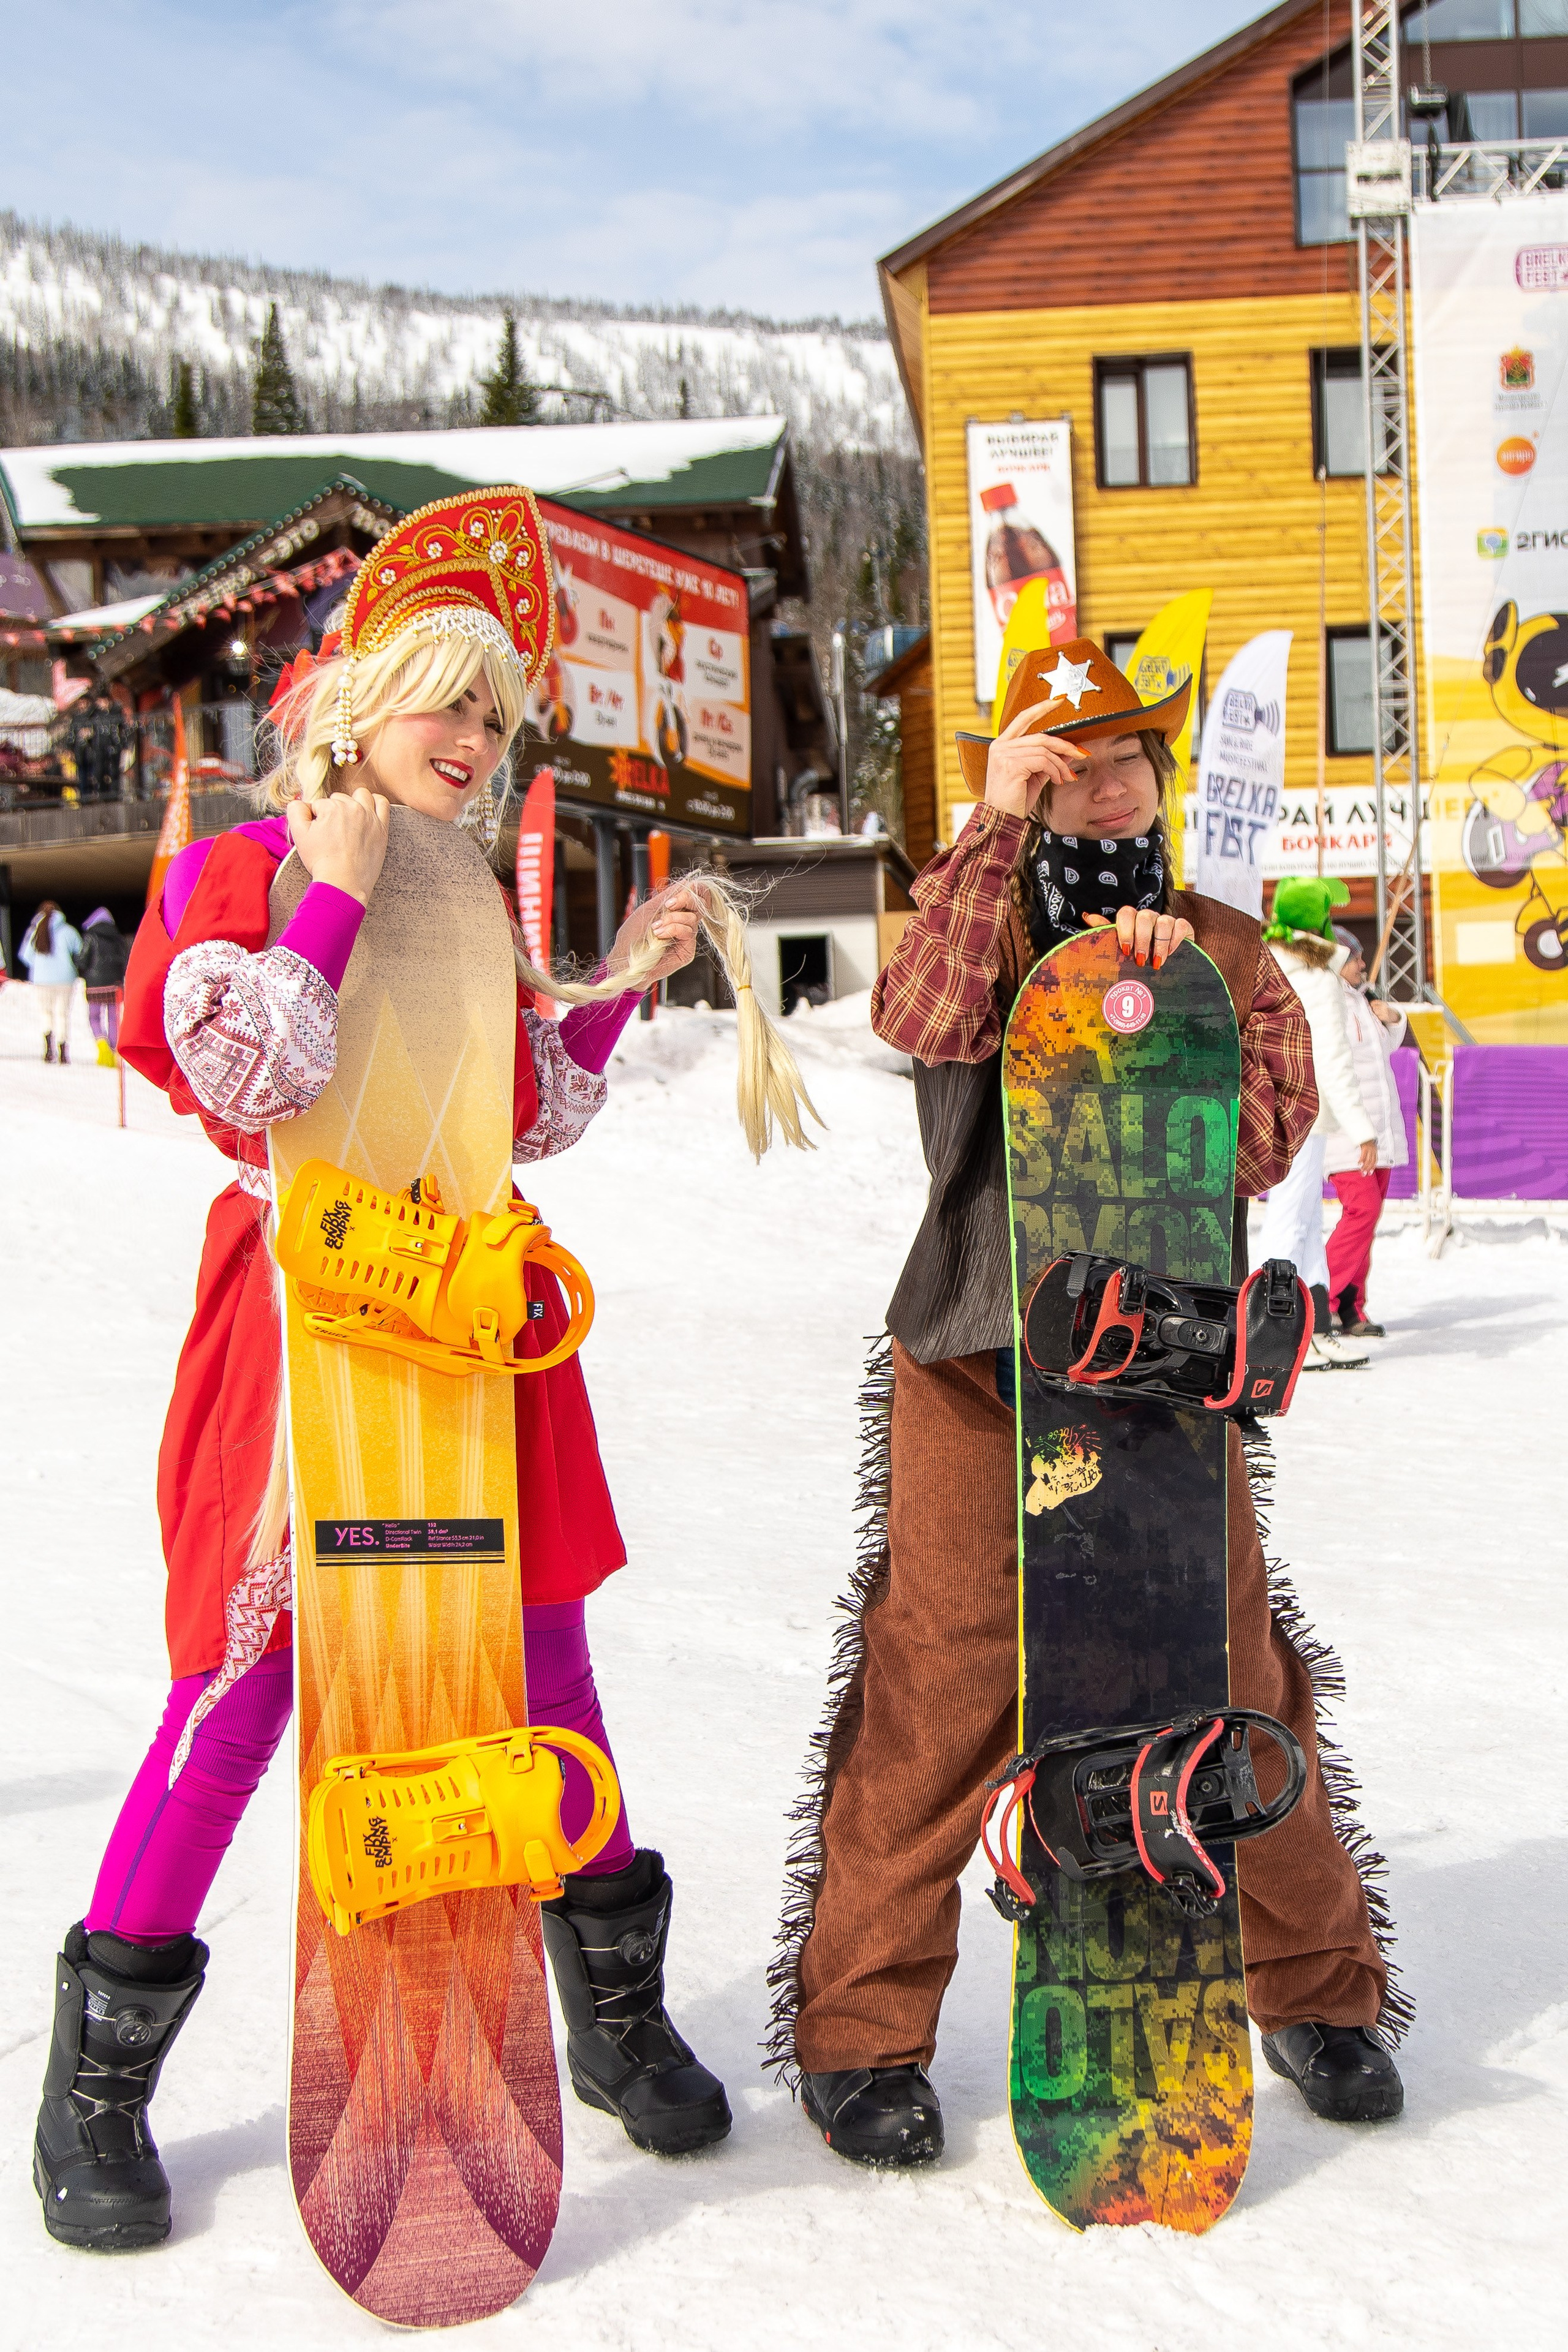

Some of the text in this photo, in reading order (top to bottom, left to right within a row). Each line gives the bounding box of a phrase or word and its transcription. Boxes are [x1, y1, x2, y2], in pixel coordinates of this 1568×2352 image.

[1109, 986, 1134, 1000] прокат
[1121, 995, 1134, 1018] 9
[533, 1303, 543, 1318] FIX
[315, 1326, 350, 1339] TRUCE
[335, 1527, 380, 1547] YES.
